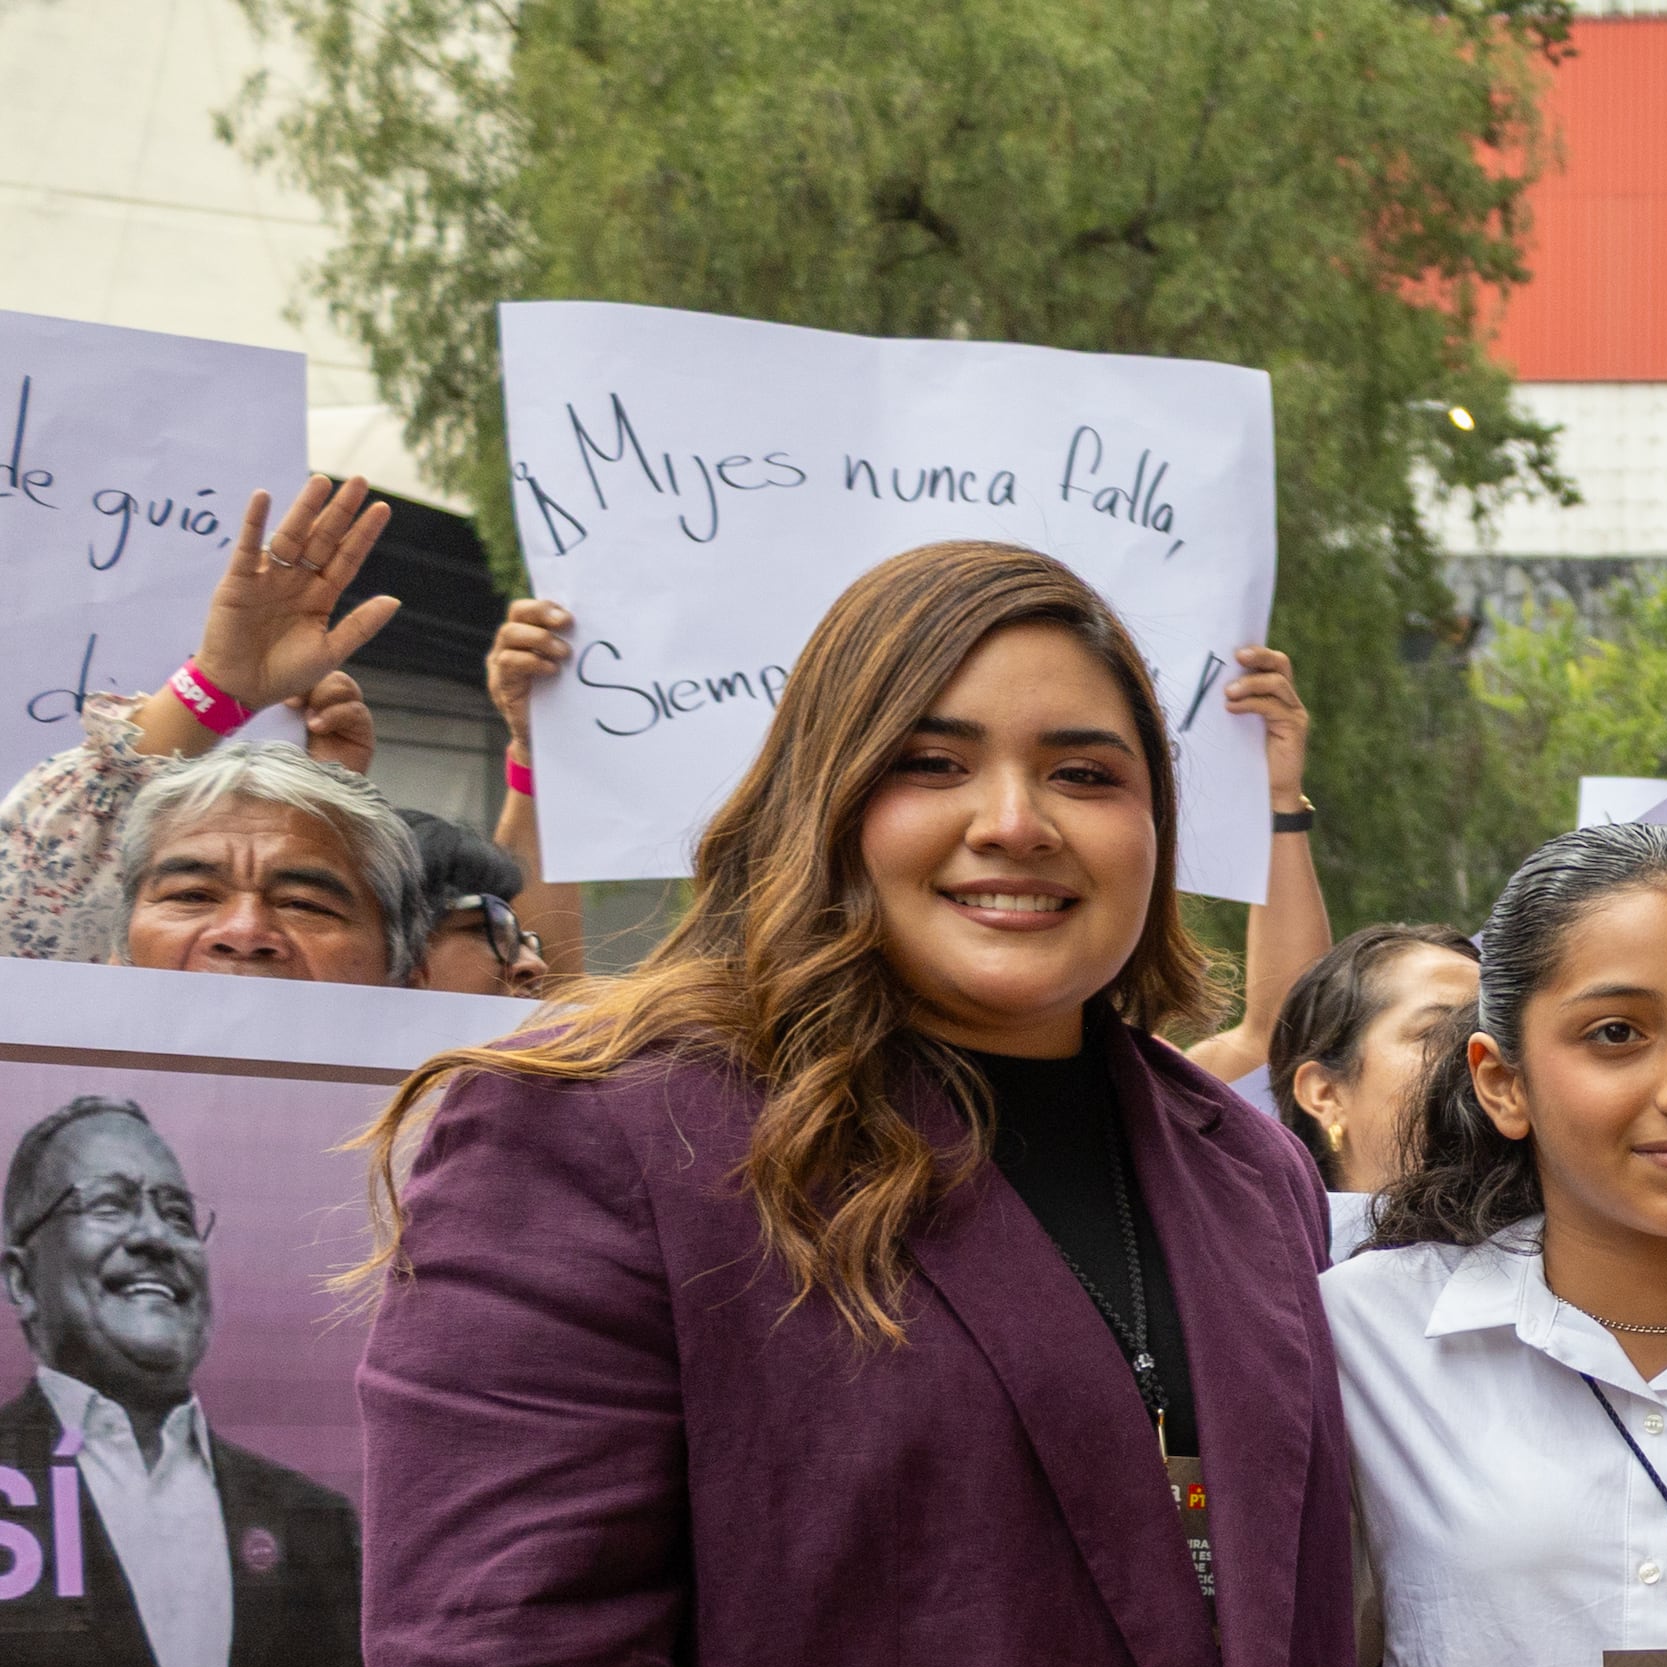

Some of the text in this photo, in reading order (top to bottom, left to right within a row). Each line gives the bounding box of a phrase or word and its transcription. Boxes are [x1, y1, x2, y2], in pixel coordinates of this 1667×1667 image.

[844, 454, 1016, 507] nunca
[1060, 425, 1185, 558] falla,
[576, 640, 791, 737] Siemp
